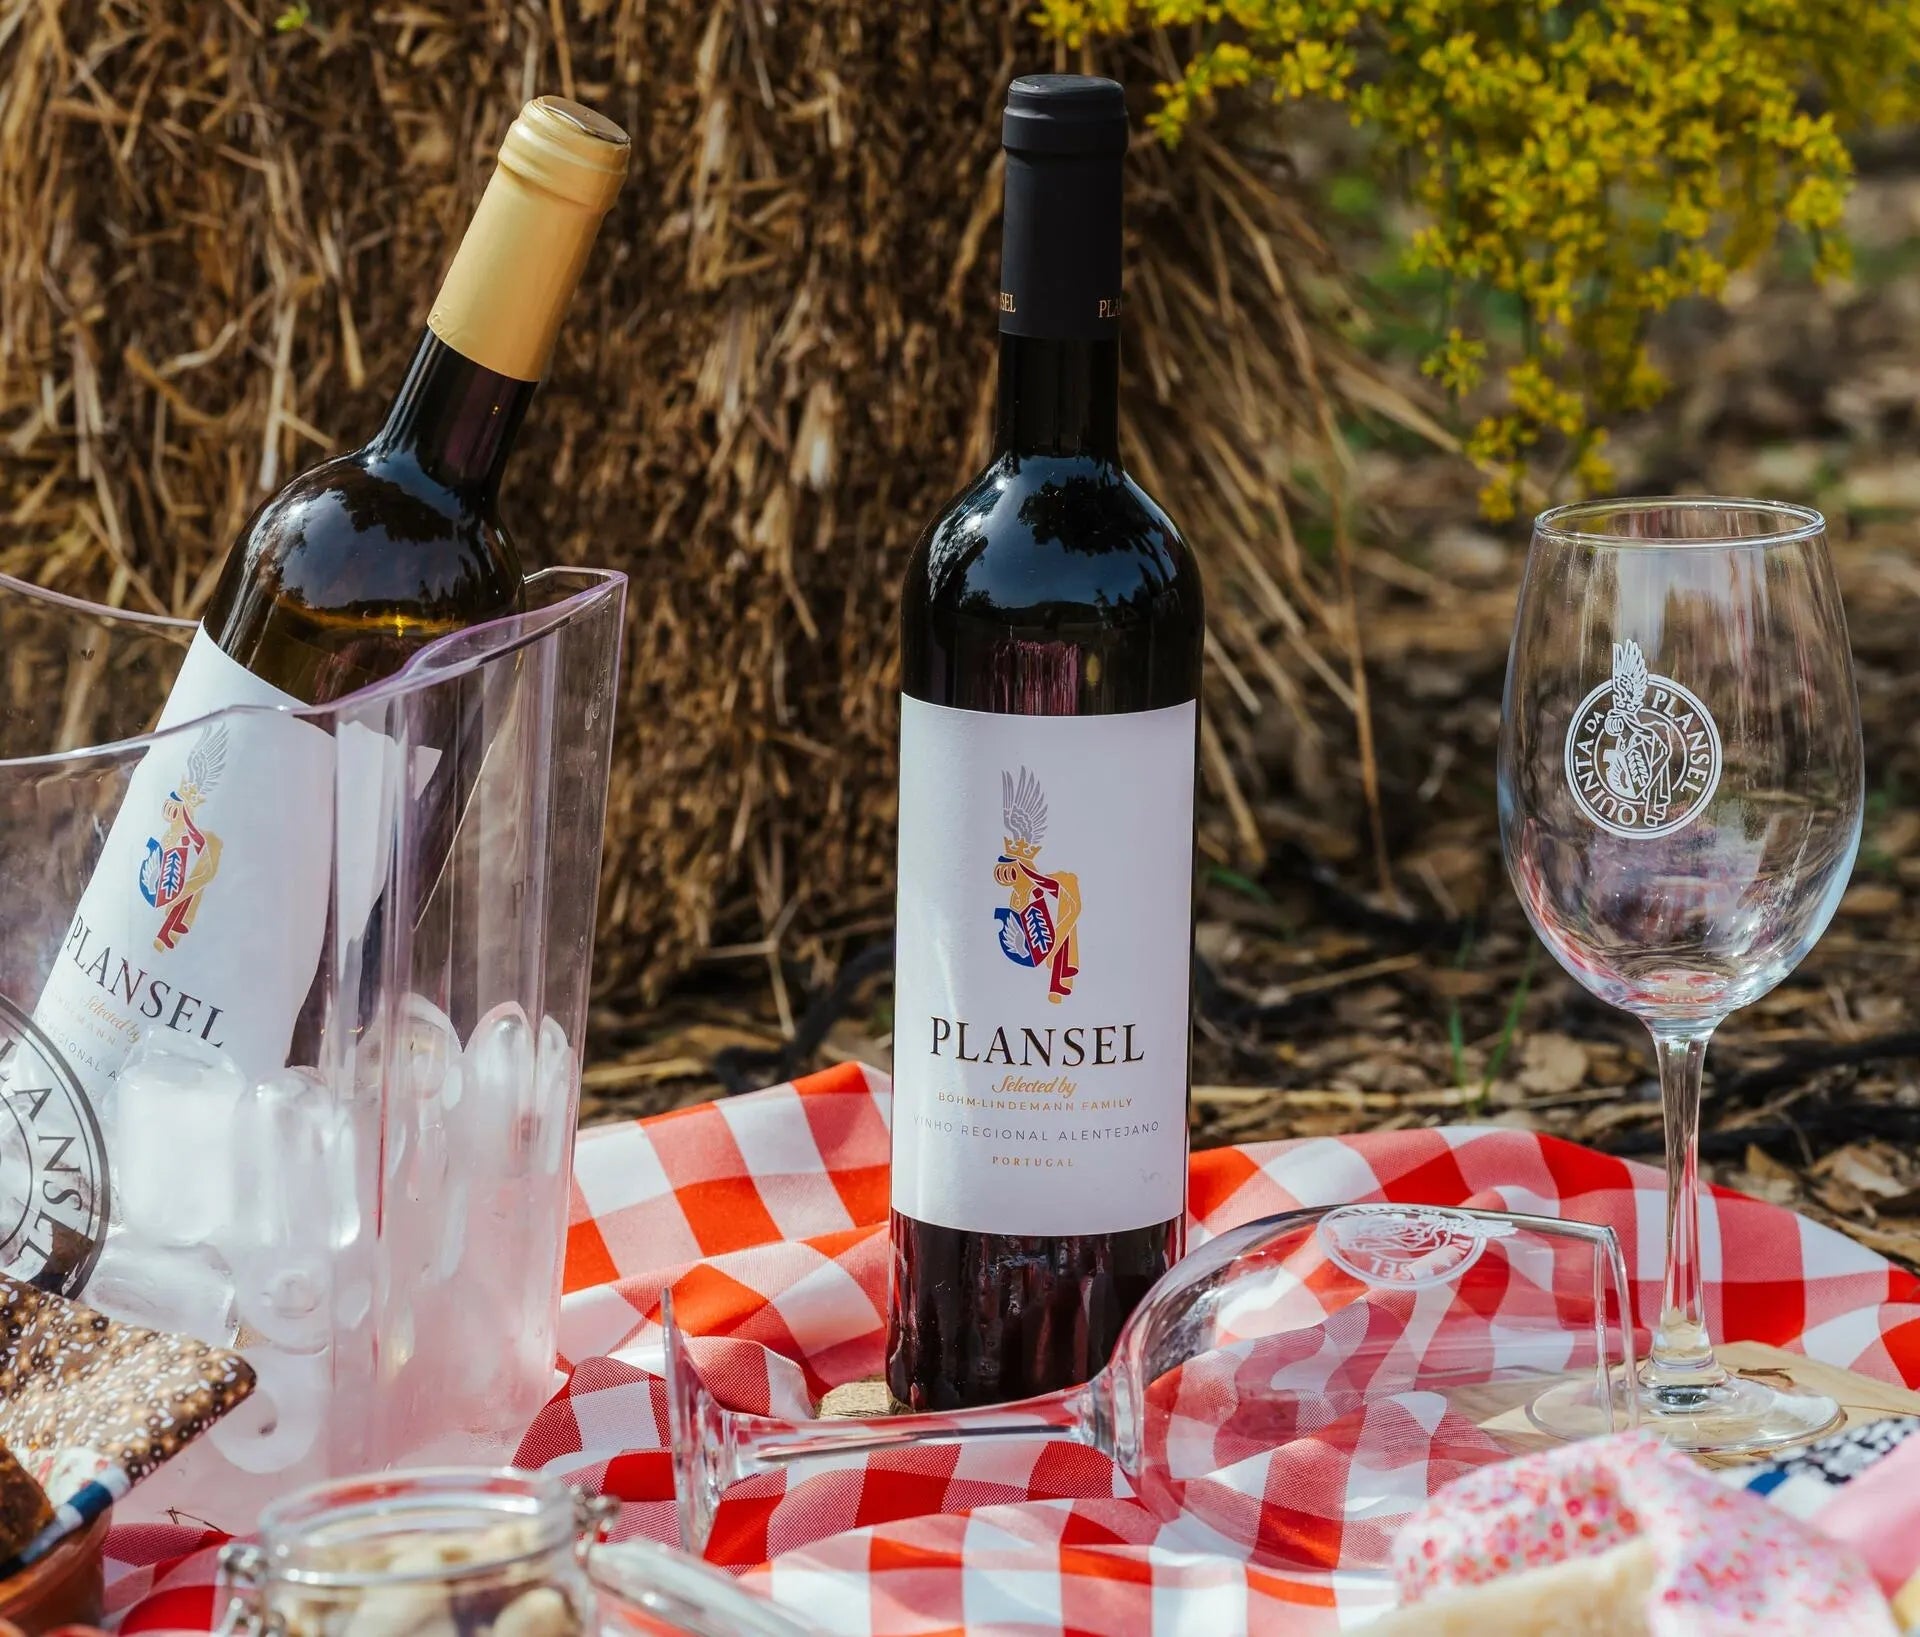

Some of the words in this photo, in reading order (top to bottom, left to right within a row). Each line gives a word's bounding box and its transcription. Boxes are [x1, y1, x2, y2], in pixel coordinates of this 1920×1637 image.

[1585, 710, 1605, 734] DA
[1651, 689, 1709, 795] PLANSEL
[1575, 738, 1637, 826] QUINTA
[65, 914, 226, 1048] PLANSEL
[930, 1016, 1145, 1067] PLANSEL
[991, 1075, 1058, 1094] Selected
[1057, 1076, 1078, 1098] by
[1081, 1097, 1133, 1112] FAMILY
[914, 1113, 953, 1133] VINHO
[961, 1124, 1048, 1141] REGIONAL
[1058, 1120, 1159, 1141] ALENTEJANO
[992, 1155, 1075, 1168] PORTUGAL
